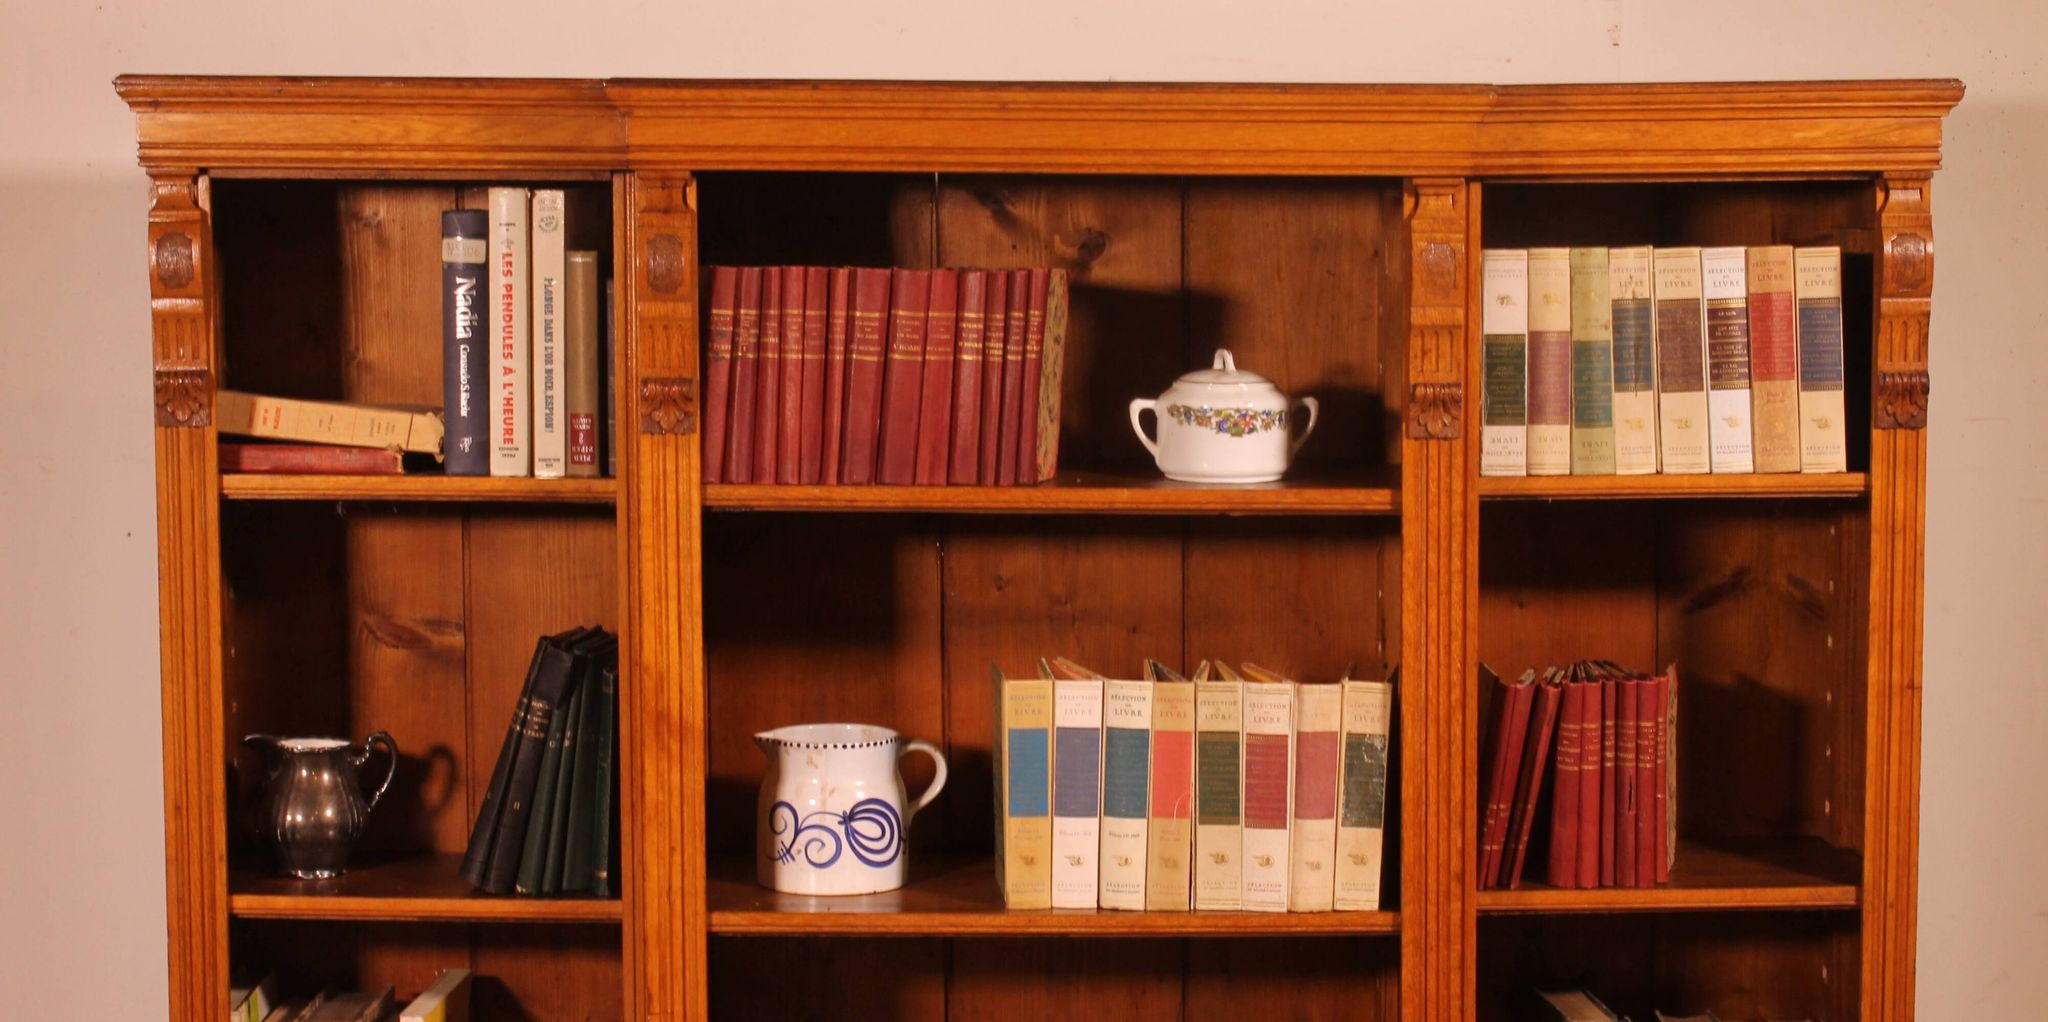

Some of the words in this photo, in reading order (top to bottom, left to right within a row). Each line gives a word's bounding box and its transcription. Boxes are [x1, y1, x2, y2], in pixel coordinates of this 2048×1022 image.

[502, 252, 513, 277] LES
[1664, 280, 1692, 289] LIVRE
[1713, 280, 1740, 288] LIVRE
[1804, 279, 1833, 288] LIVRE
[453, 276, 479, 339] Nadia
[543, 277, 555, 315] PLONGE
[502, 283, 513, 360] PENDULES
[543, 319, 554, 343] DANS
[502, 366, 515, 376] À
[502, 382, 514, 445] L'HEURE
[1114, 708, 1142, 718] LIVRE
